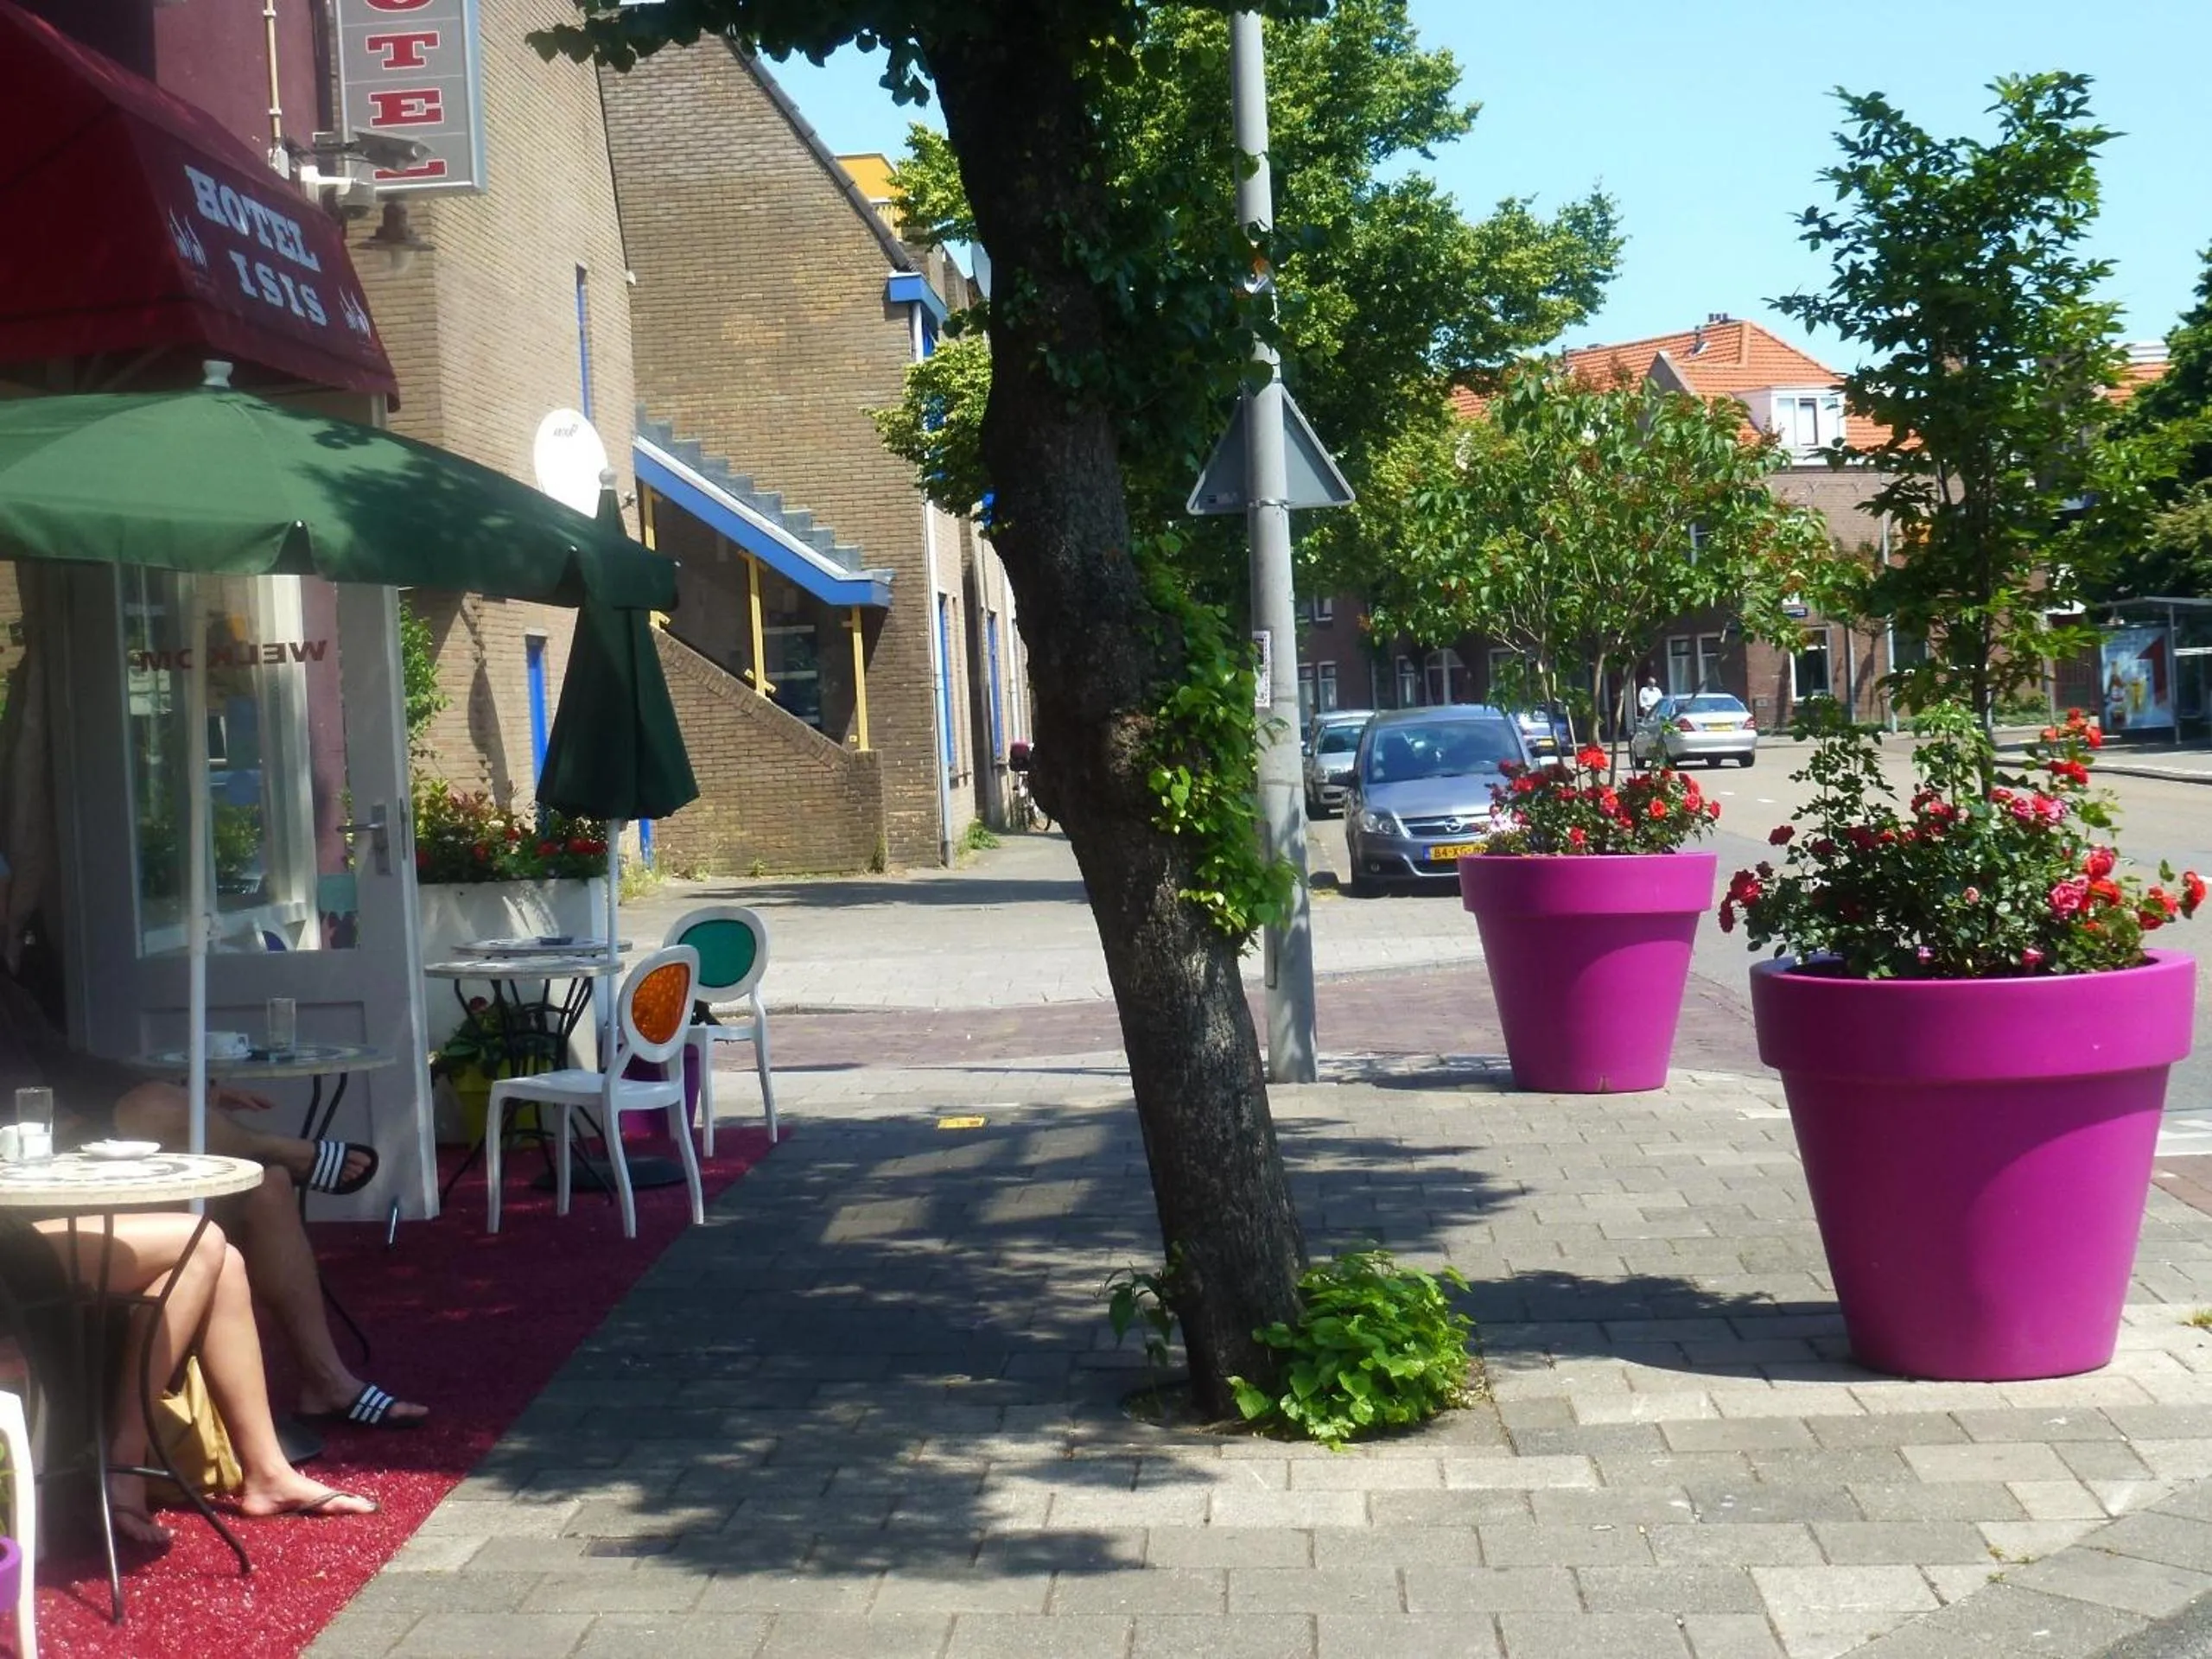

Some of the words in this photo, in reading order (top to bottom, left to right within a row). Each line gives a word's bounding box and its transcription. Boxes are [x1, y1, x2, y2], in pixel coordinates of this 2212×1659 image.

[365, 0, 448, 181] TE
[184, 164, 321, 273] HOTEL
[228, 250, 327, 326] ISIS
